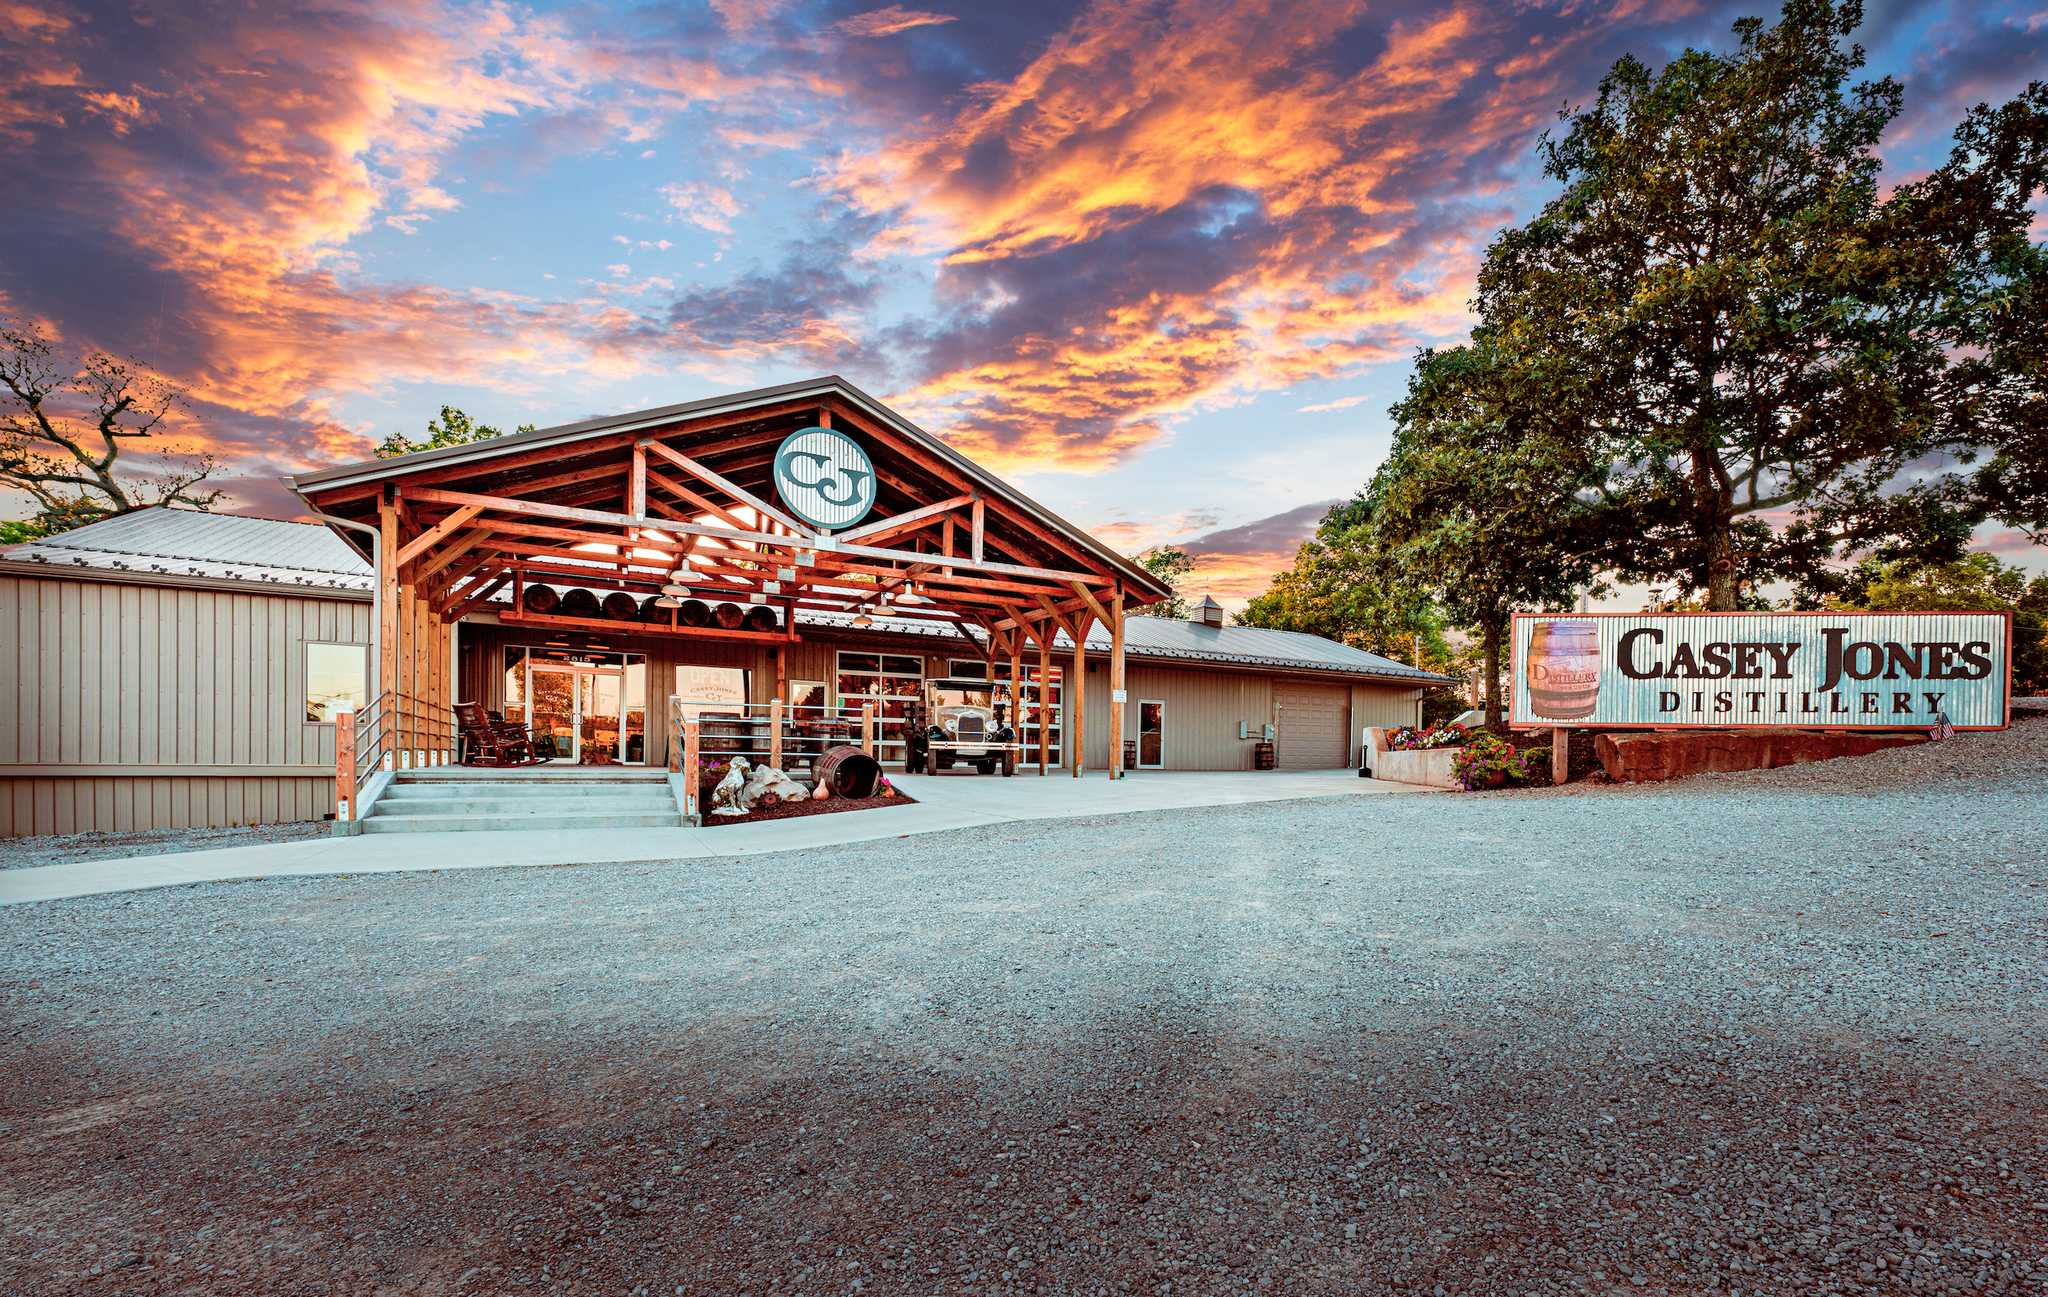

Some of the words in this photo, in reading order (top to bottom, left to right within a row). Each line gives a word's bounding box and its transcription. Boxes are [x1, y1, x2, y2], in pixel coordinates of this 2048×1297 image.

[780, 451, 870, 506] CJ
[1617, 627, 1802, 680] CASEY
[1818, 627, 1992, 693] JONES
[1659, 691, 1945, 714] DISTILLERY
